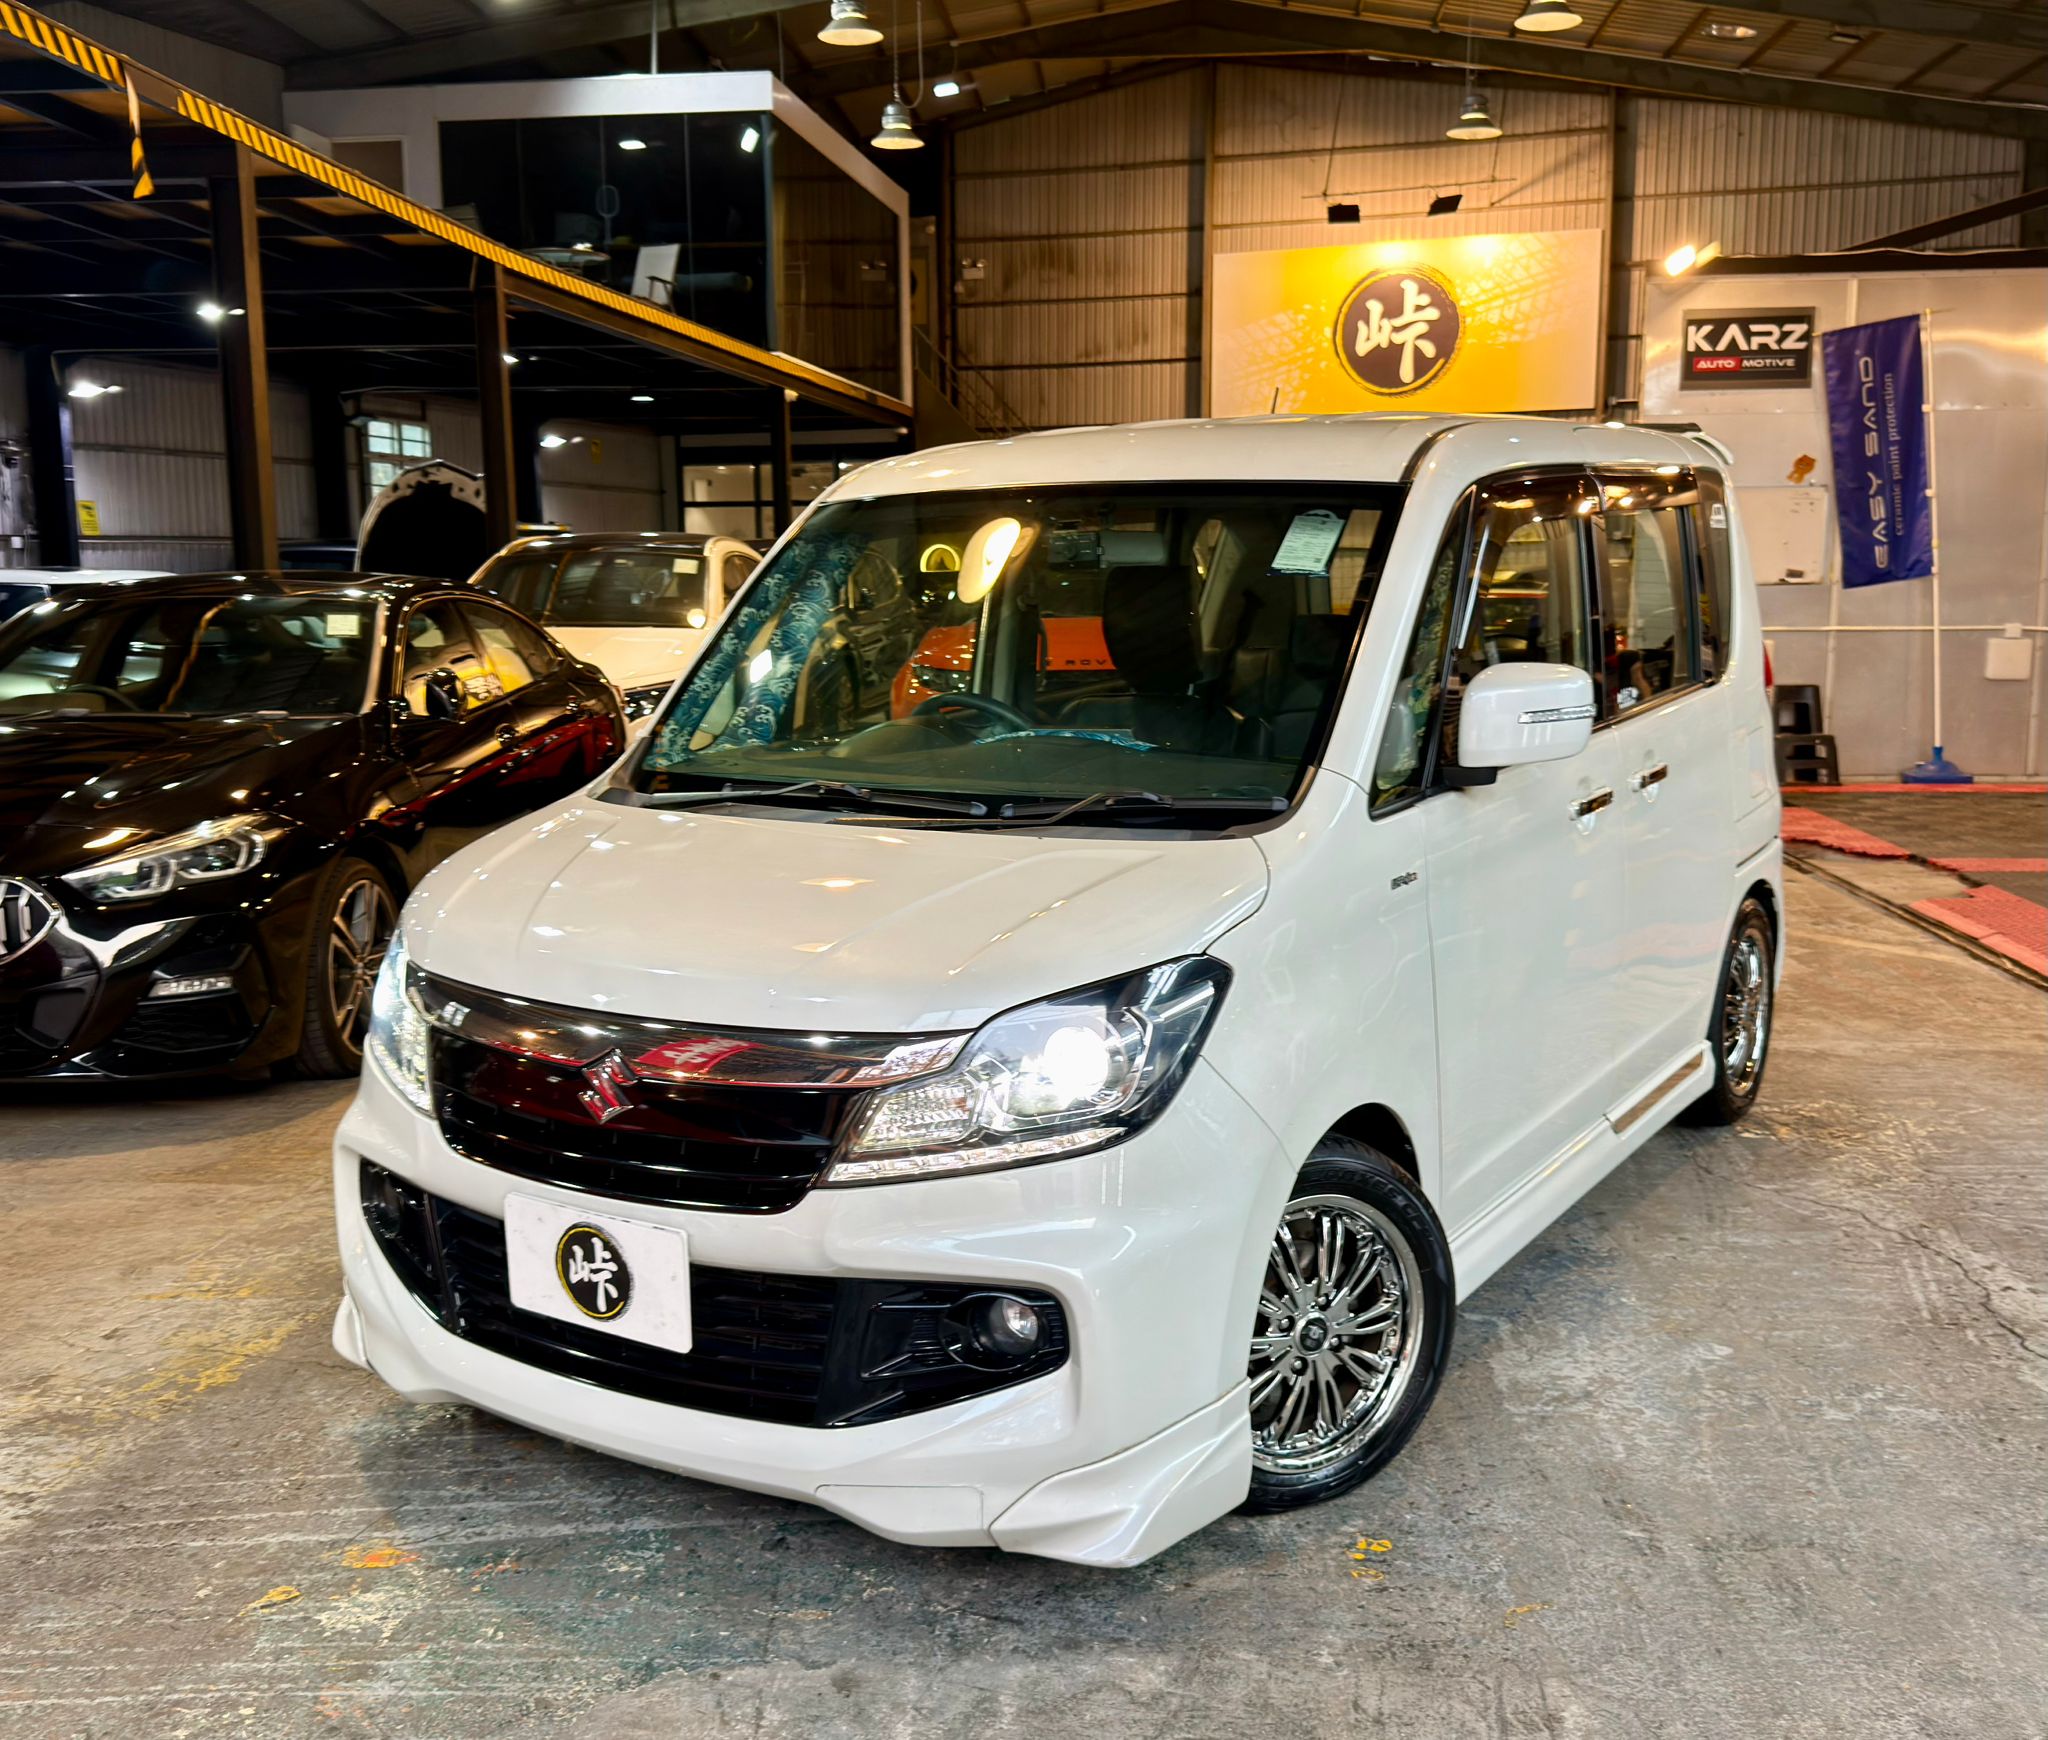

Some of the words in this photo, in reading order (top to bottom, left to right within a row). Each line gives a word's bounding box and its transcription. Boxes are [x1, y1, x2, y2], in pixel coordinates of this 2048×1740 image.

[1355, 279, 1440, 384] 峠
[1686, 323, 1809, 352] KARZ
[1696, 359, 1737, 369] AUTO
[1741, 358, 1796, 368] MOTIVE
[1859, 356, 1879, 457] SAND
[1883, 373, 1901, 441] protection
[1888, 446, 1904, 480] paint
[1866, 471, 1889, 569] EASY
[1892, 484, 1904, 536] ceramic
[568, 1236, 619, 1313] 峠
